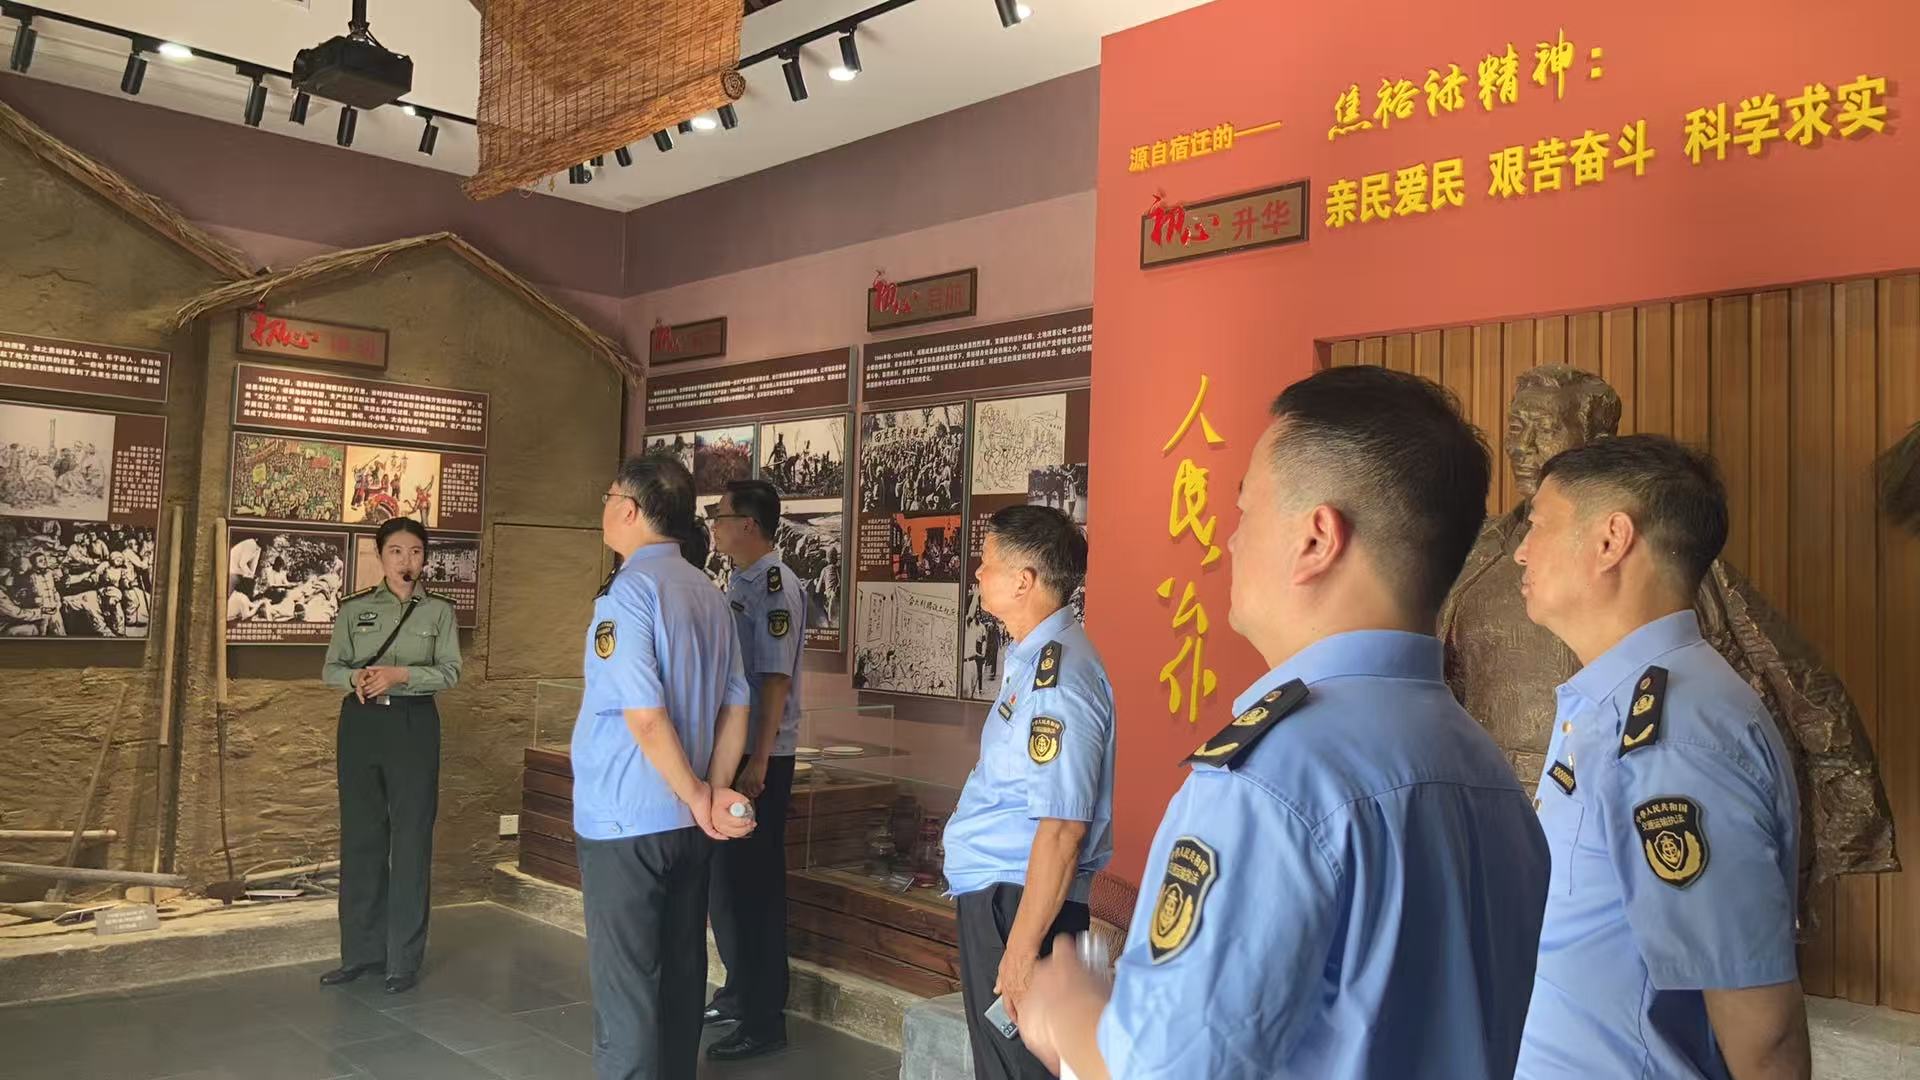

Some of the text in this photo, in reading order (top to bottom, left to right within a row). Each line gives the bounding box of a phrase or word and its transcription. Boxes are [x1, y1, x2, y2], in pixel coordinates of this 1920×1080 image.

[1232, 201, 1292, 241] 升华
[1325, 74, 1889, 229] 亲民爱民 艰苦奋斗 科学求实
[1155, 374, 1226, 724] 人民公仆
